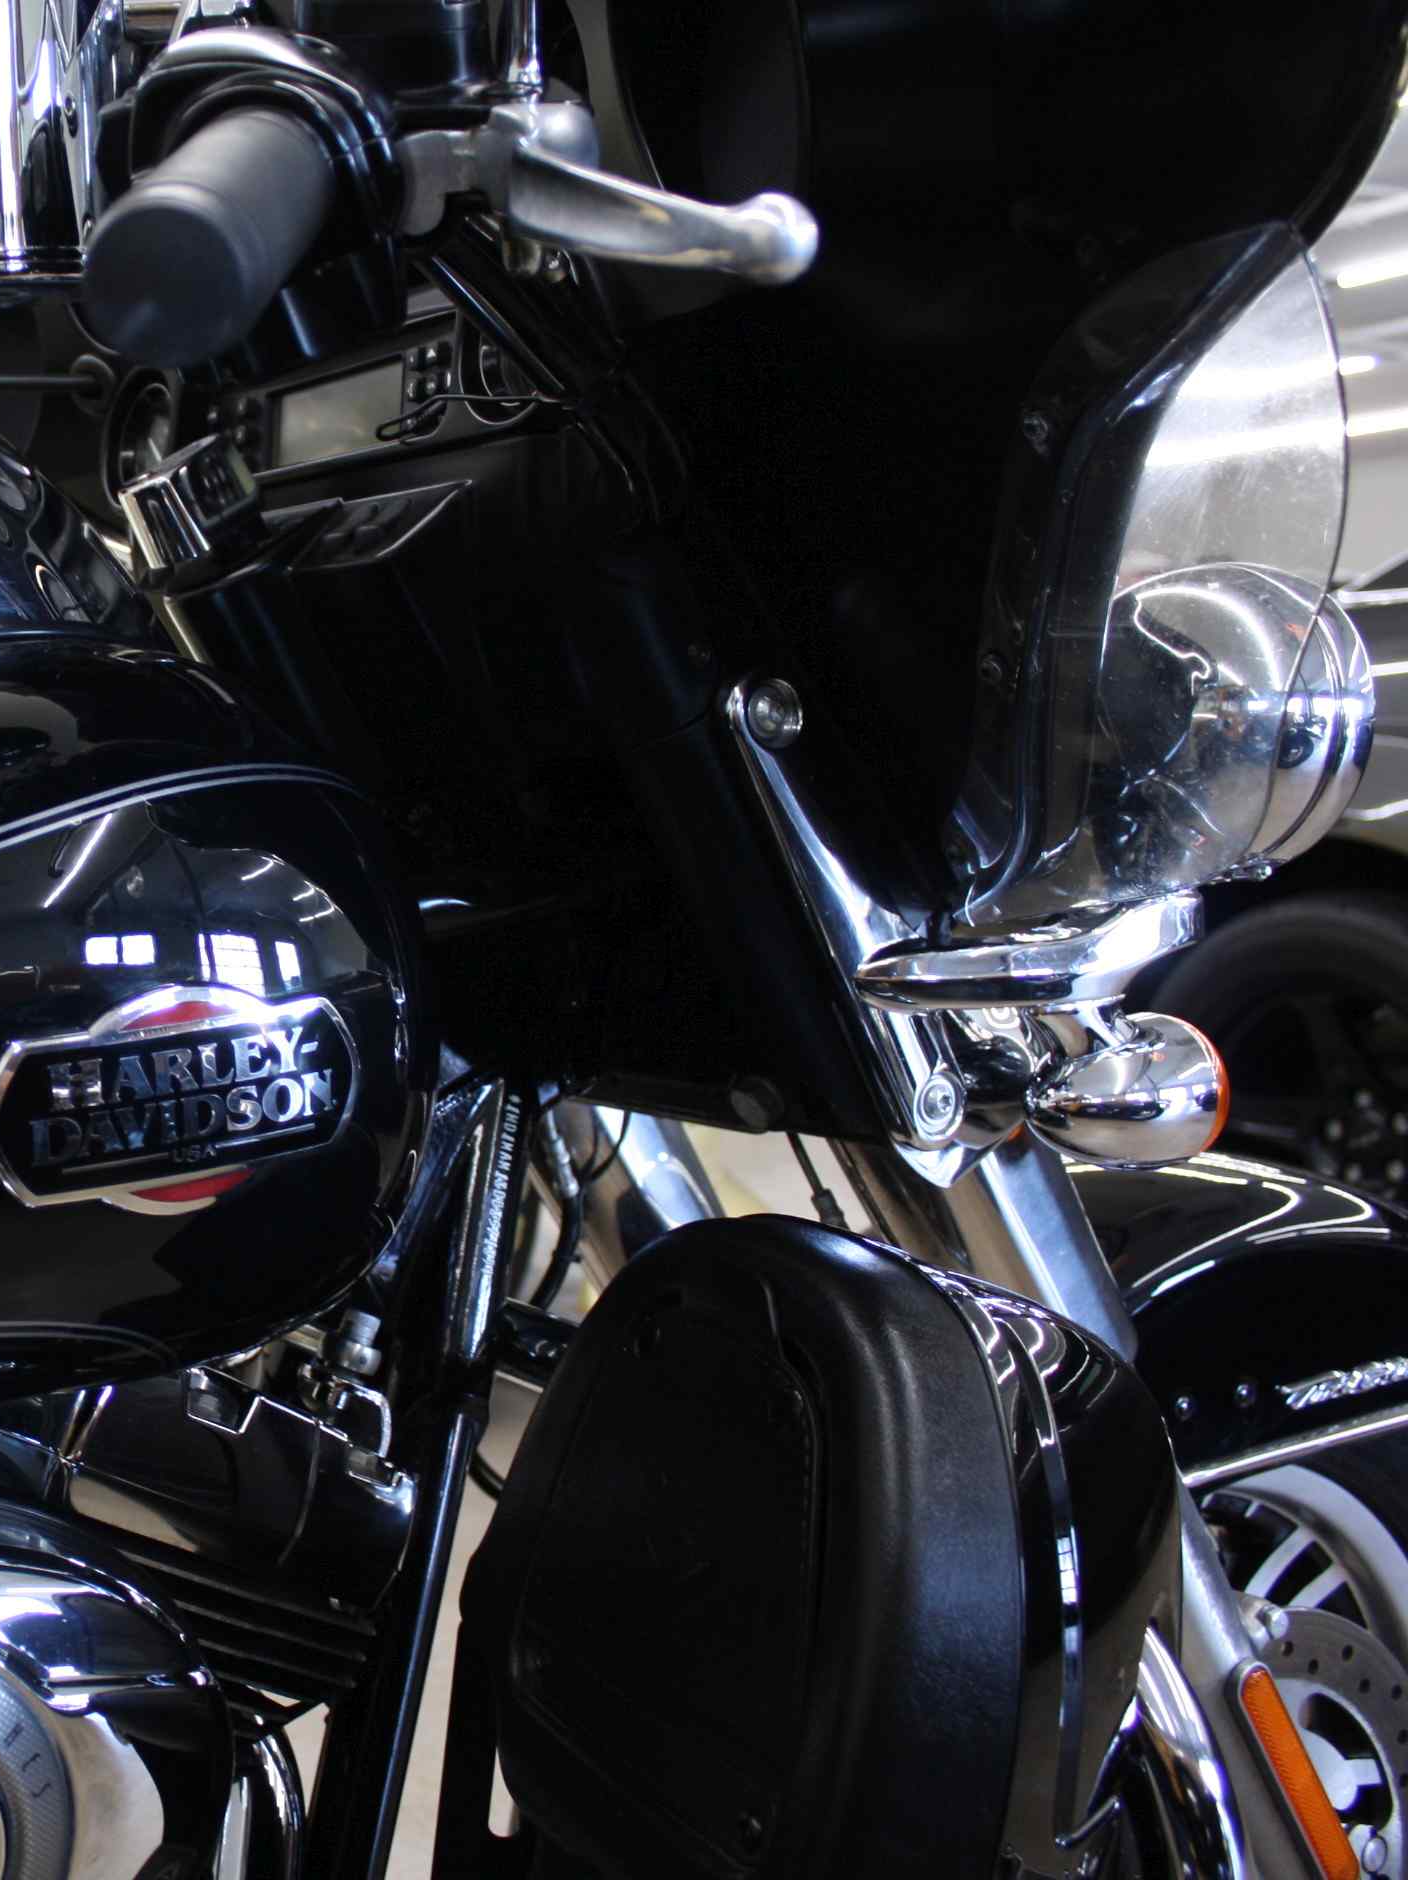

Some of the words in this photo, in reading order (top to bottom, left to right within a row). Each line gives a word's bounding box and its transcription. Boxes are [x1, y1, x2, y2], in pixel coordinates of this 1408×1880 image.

[46, 1026, 319, 1112] HARLEY-
[29, 1067, 336, 1168] DAVIDSON
[172, 1143, 218, 1164] USA
